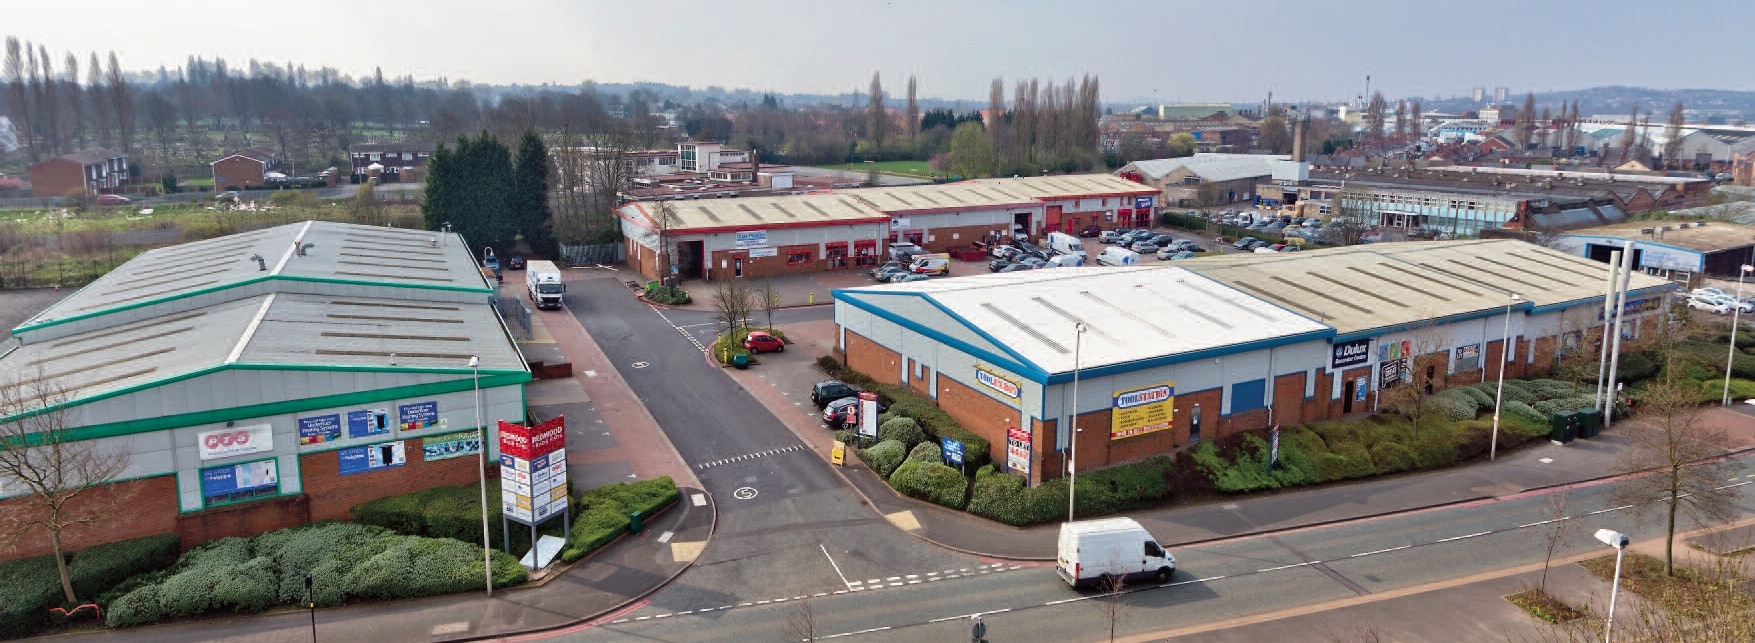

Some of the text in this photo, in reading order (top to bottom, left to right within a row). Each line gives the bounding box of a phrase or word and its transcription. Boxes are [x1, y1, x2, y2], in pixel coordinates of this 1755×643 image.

[1343, 343, 1367, 356] Dulux
[1121, 389, 1168, 405] TOOLSTATION
[531, 426, 563, 443] REDWOOD
[1010, 439, 1018, 447] TO
